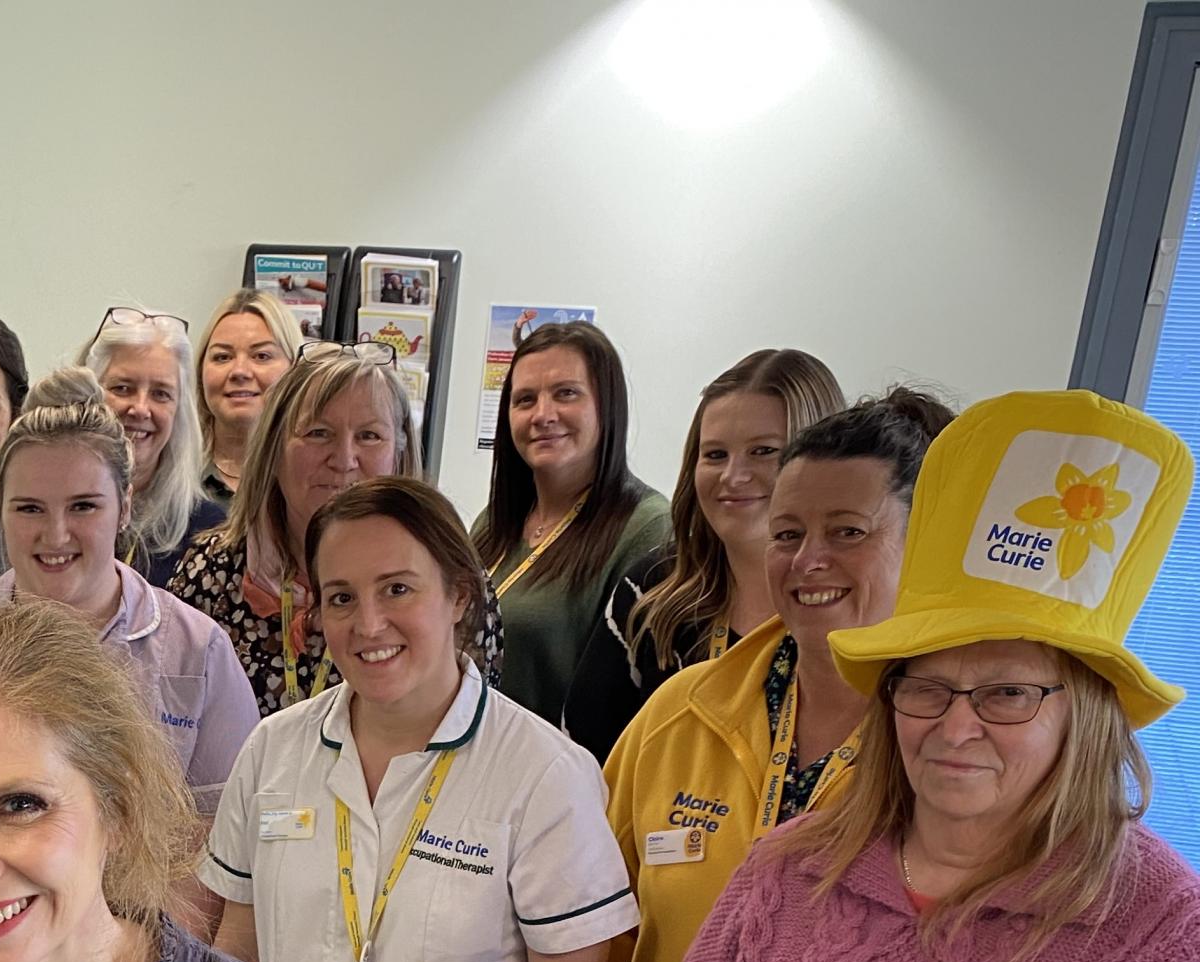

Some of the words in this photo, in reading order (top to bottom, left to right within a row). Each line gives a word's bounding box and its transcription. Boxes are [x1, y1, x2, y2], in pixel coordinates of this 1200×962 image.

[986, 523, 1052, 552] Marie
[987, 544, 1045, 570] Curie
[160, 711, 195, 729] Marie
[767, 775, 779, 800] Marie
[673, 792, 729, 817] Marie
[762, 799, 775, 827] Curie
[669, 810, 719, 832] Curie
[416, 829, 453, 850] Marie
[455, 839, 489, 857] Curie
[410, 848, 455, 868] ccupational
[454, 858, 494, 875] Therapist
